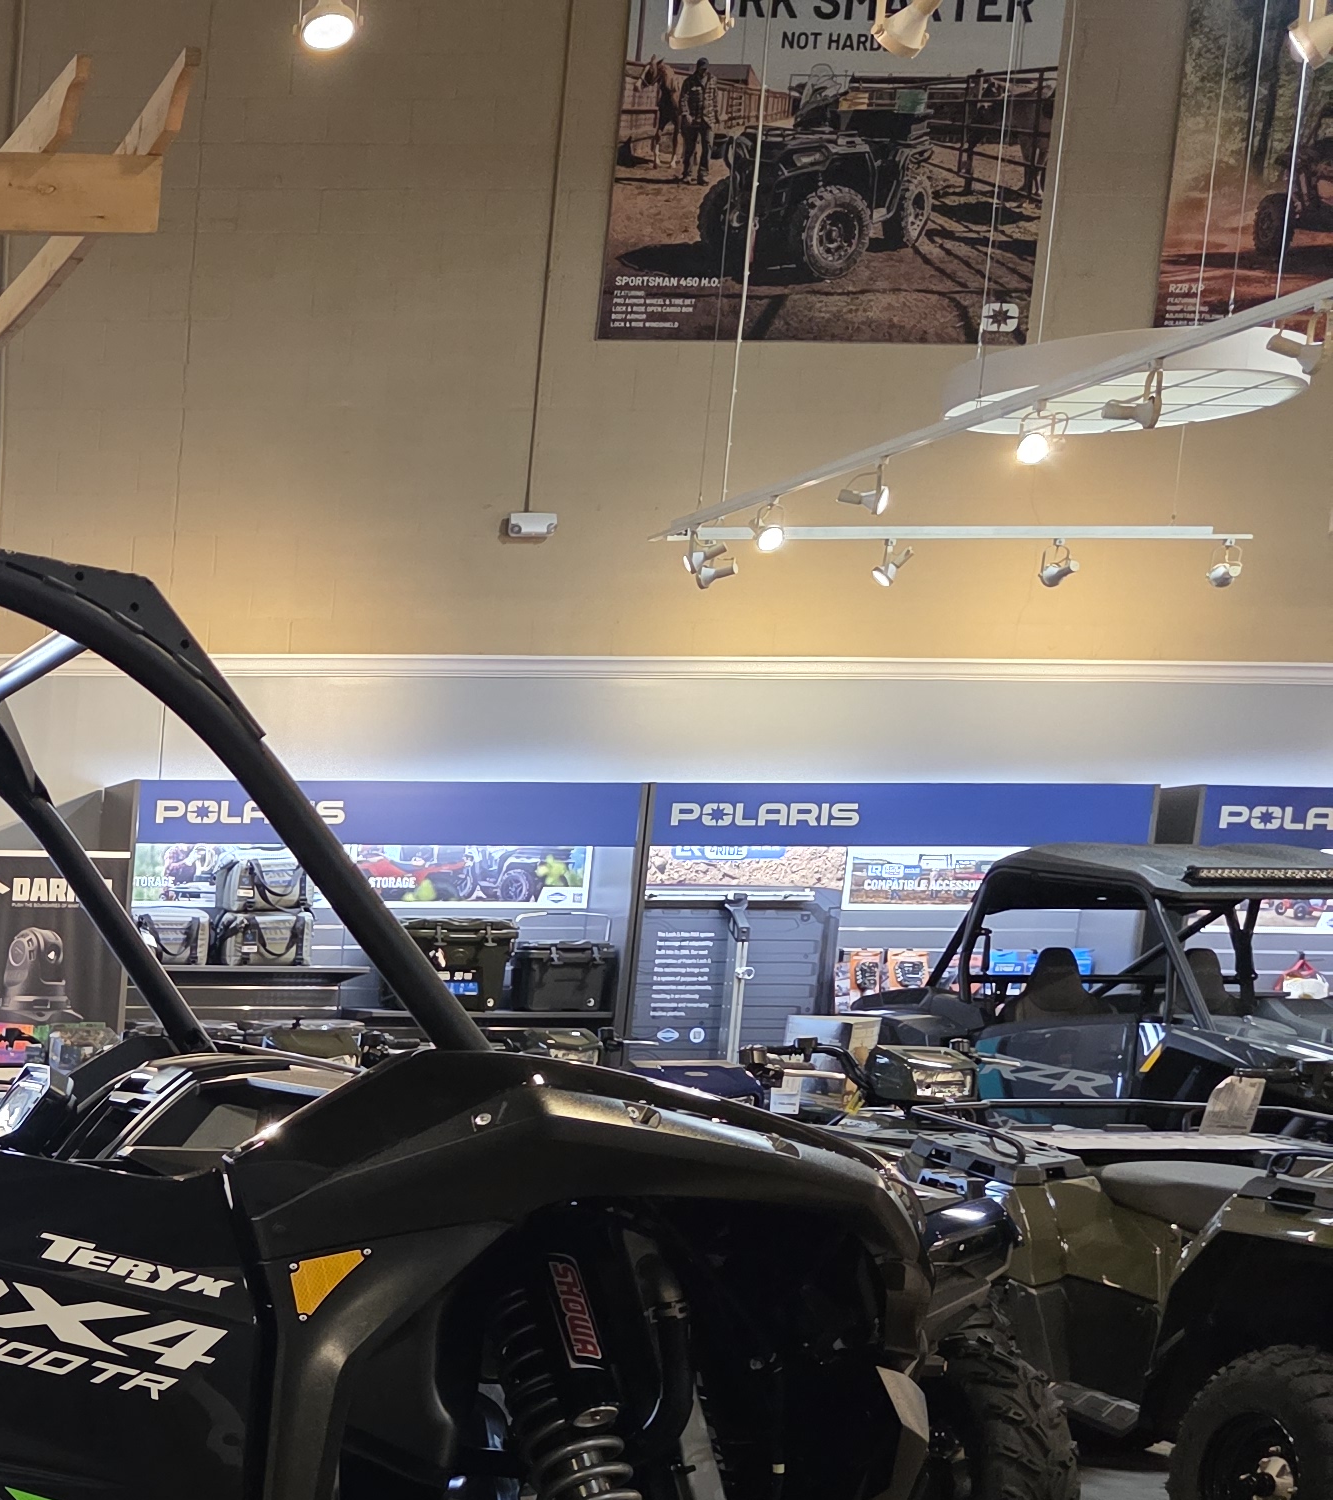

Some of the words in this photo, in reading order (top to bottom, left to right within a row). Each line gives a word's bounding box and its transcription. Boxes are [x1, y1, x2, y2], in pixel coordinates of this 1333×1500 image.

[781, 31, 822, 50] NOT
[827, 33, 888, 51] HARD
[615, 277, 677, 287] SPORTSMAN
[679, 278, 698, 287] 450
[701, 278, 720, 287] H.O.
[1169, 284, 1189, 293] RZR
[155, 800, 345, 825] POLAS
[670, 802, 860, 826] POLARIS
[1219, 805, 1333, 831] POLA
[864, 879, 929, 890] COMPATIBLE
[548, 1261, 603, 1360] SHOWA
[89, 1360, 180, 1401] TR
